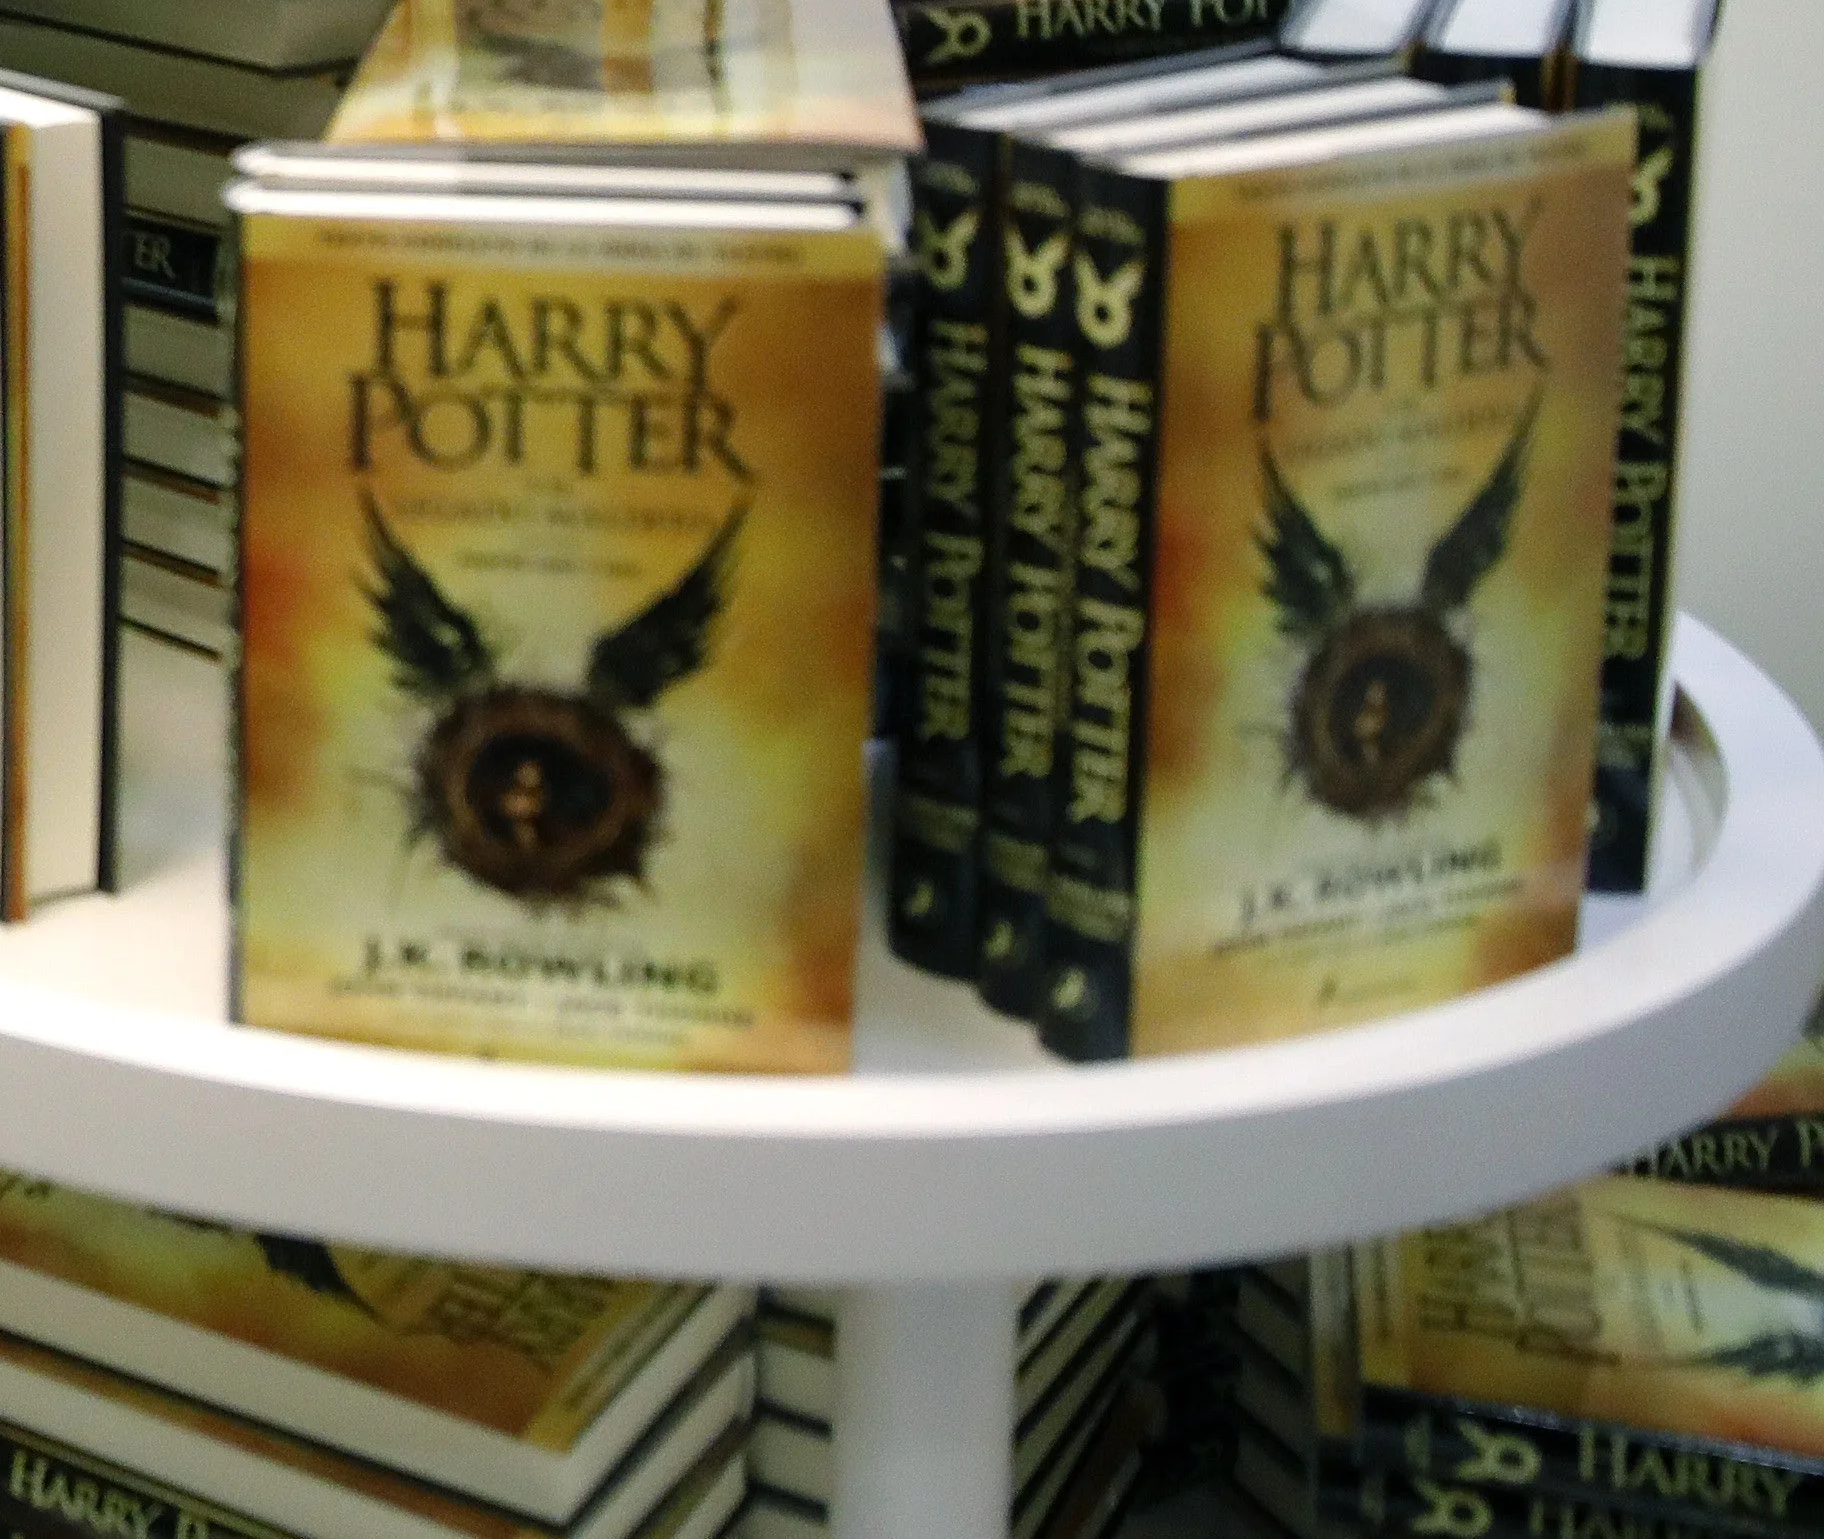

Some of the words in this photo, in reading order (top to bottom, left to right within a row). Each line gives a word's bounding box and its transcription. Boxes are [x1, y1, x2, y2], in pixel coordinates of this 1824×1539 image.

[1277, 194, 1549, 327] HARRY
[373, 274, 745, 393] HARRY
[1253, 289, 1550, 424] POTTER
[346, 364, 759, 492] POTTER
